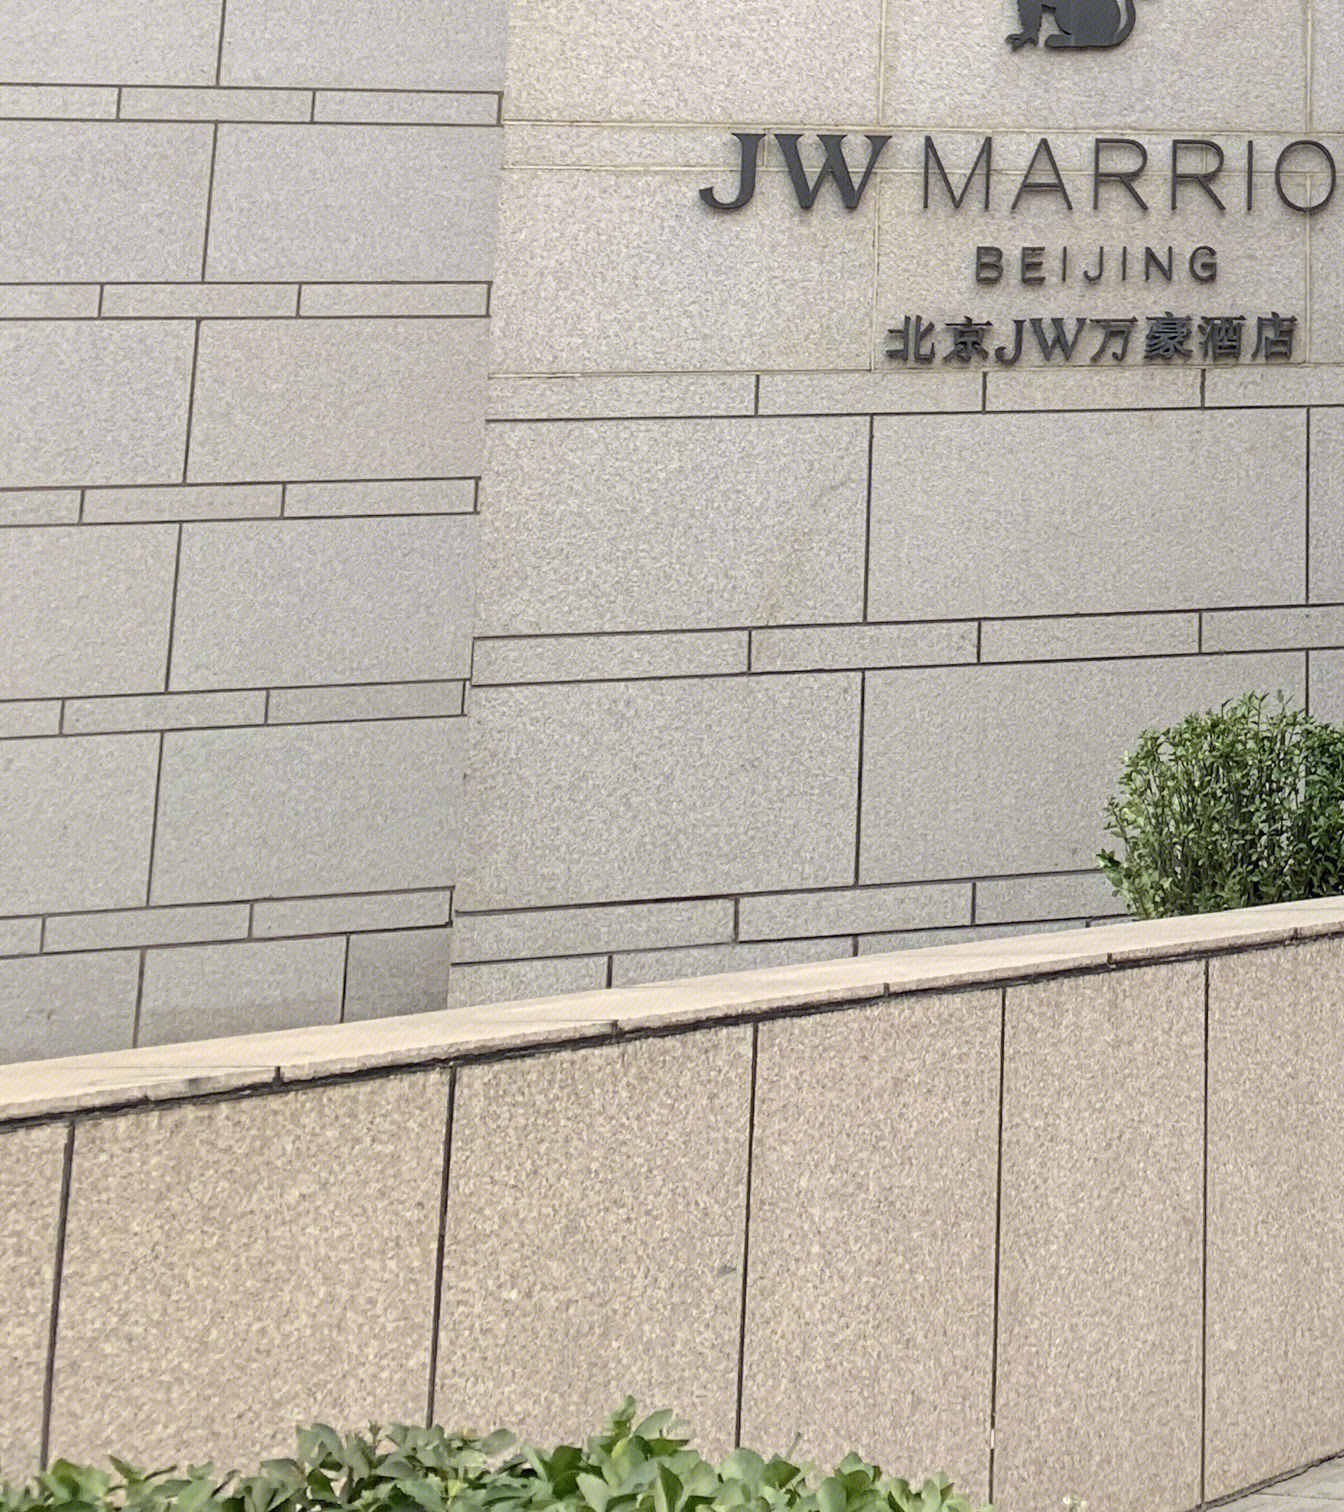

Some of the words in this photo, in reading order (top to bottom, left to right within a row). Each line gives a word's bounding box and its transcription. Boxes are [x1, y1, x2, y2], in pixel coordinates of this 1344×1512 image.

[699, 132, 893, 211] JW
[974, 245, 1219, 284] BEIJING
[886, 311, 1299, 366] 北京JW万豪酒店
